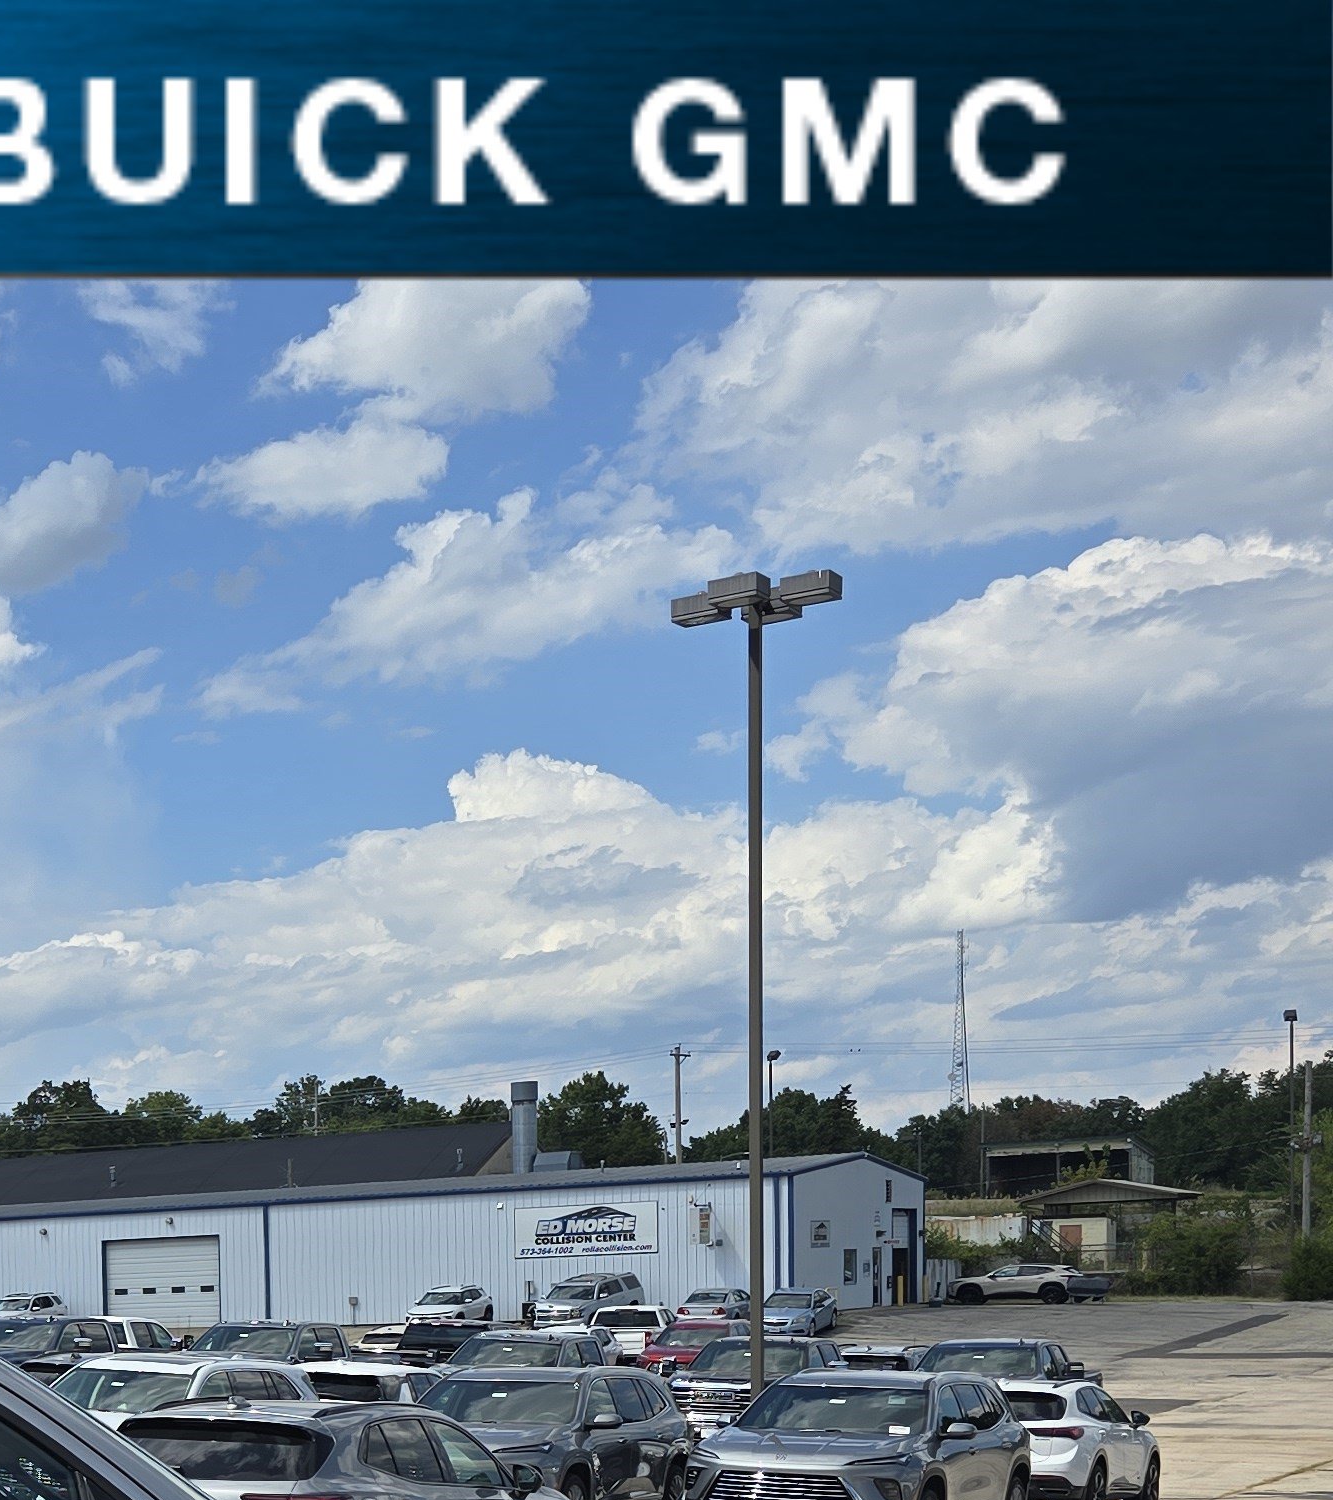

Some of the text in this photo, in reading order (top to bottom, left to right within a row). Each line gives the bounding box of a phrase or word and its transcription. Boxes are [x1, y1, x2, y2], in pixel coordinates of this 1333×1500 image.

[537, 1216, 635, 1235] ED MORSE
[535, 1233, 636, 1246] COLLISION CENTER
